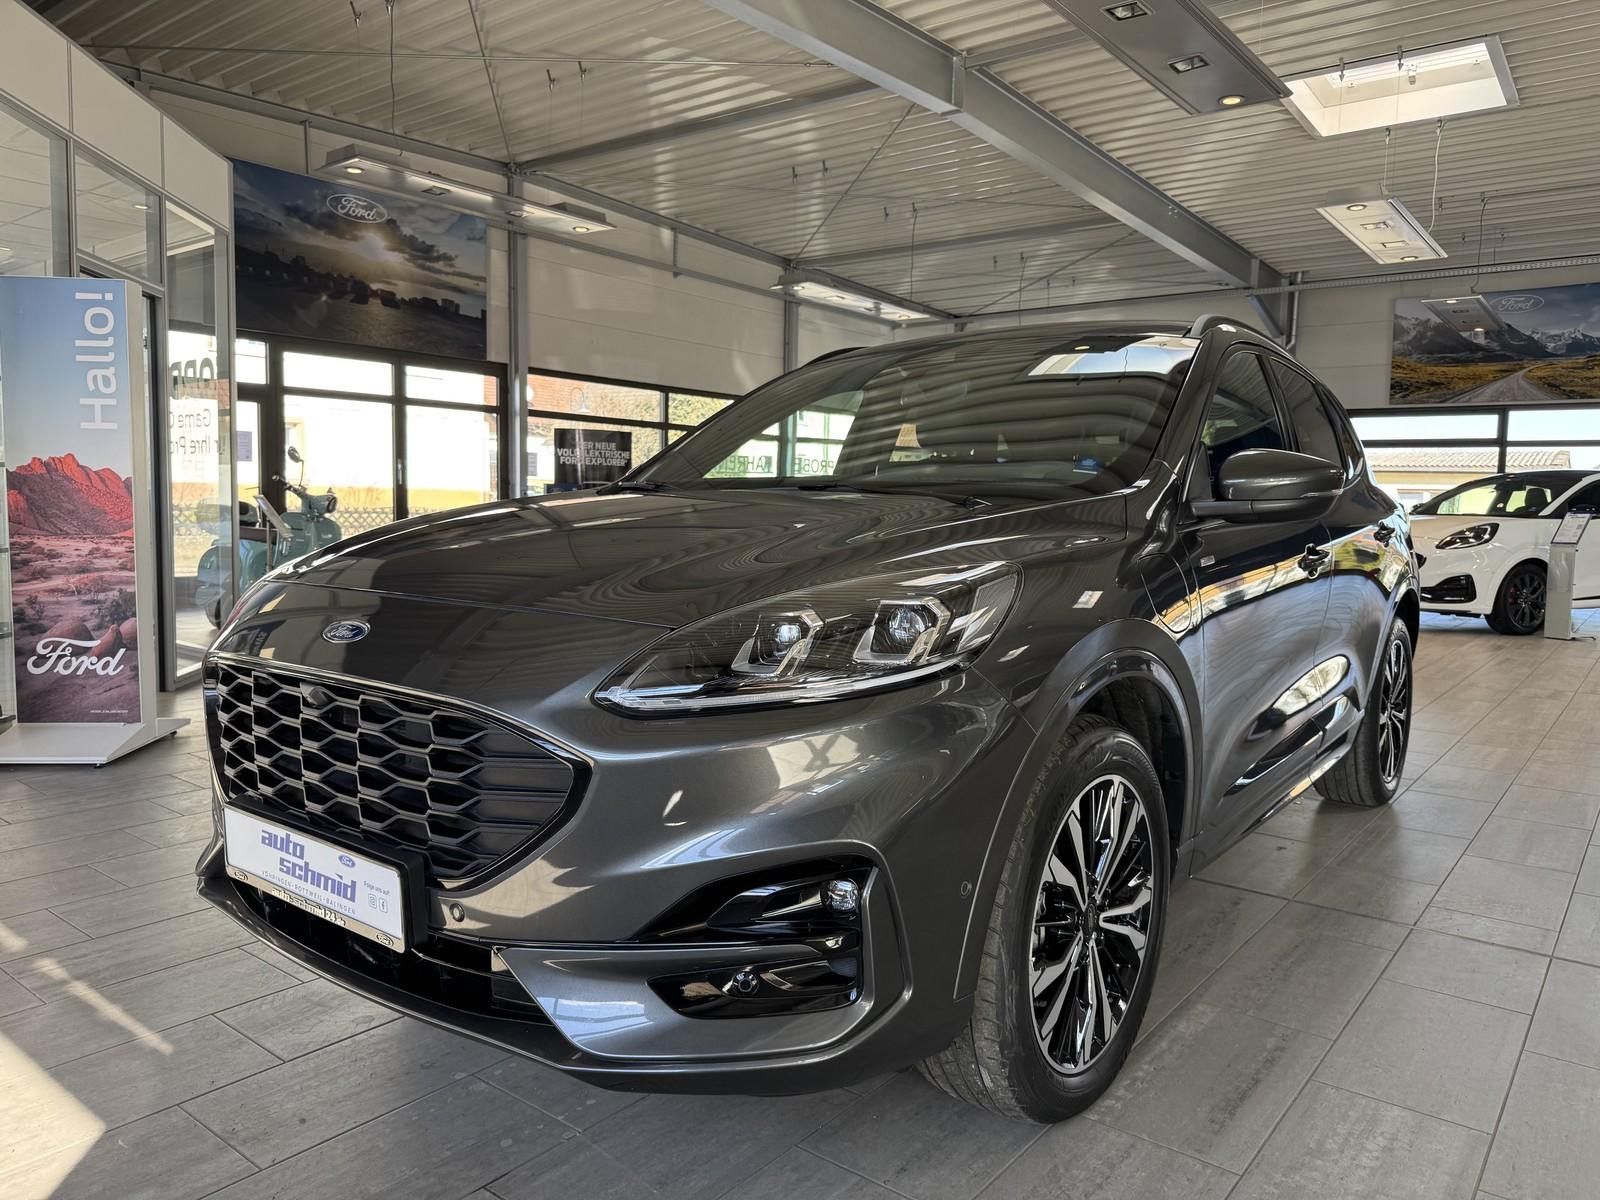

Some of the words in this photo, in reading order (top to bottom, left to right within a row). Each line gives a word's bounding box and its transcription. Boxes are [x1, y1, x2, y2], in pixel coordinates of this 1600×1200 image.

[338, 197, 378, 220] Ford
[1499, 297, 1535, 311] Ford
[74, 290, 118, 430] Hallo!
[578, 441, 594, 450] ER
[595, 442, 617, 451] NEUE
[26, 636, 128, 676] Ford
[261, 829, 305, 861] auto
[279, 857, 357, 903] schmid
